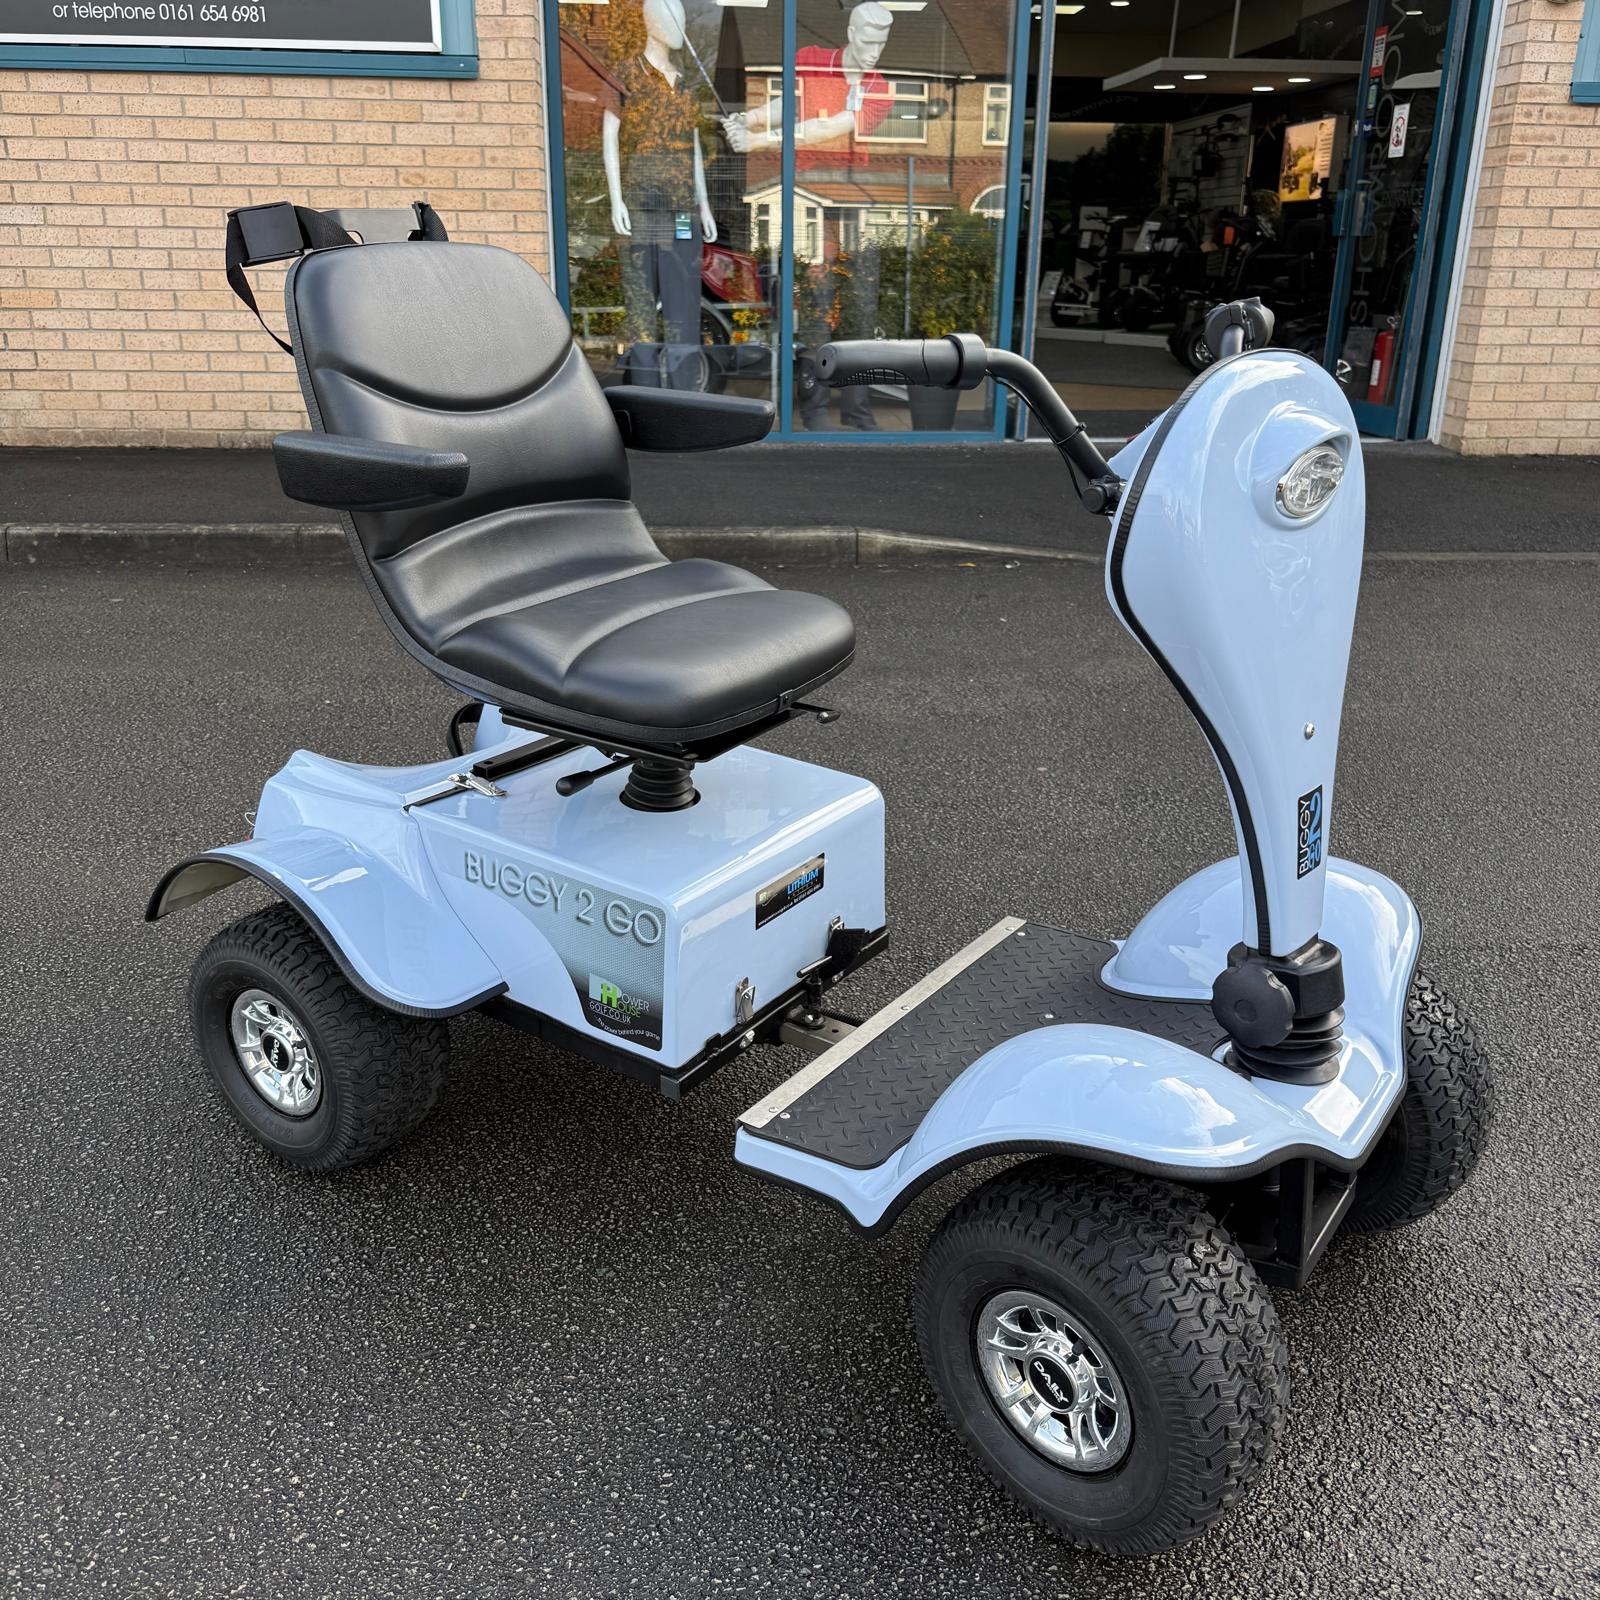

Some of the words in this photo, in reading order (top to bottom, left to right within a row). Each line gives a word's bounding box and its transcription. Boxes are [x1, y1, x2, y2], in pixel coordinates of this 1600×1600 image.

[52, 4, 68, 18] or
[72, 1, 156, 23] telephone
[159, 3, 194, 21] 0161
[200, 4, 228, 22] 654
[231, 5, 266, 23] 6981
[1299, 800, 1310, 874] BUGGY
[1308, 791, 1321, 845] 2
[464, 850, 569, 913] BUGGY
[576, 888, 595, 925] 2
[604, 899, 662, 946] GO
[787, 868, 819, 895] LITHIUM
[645, 1030, 660, 1040] game
[1033, 1361, 1069, 1403] DAILY
